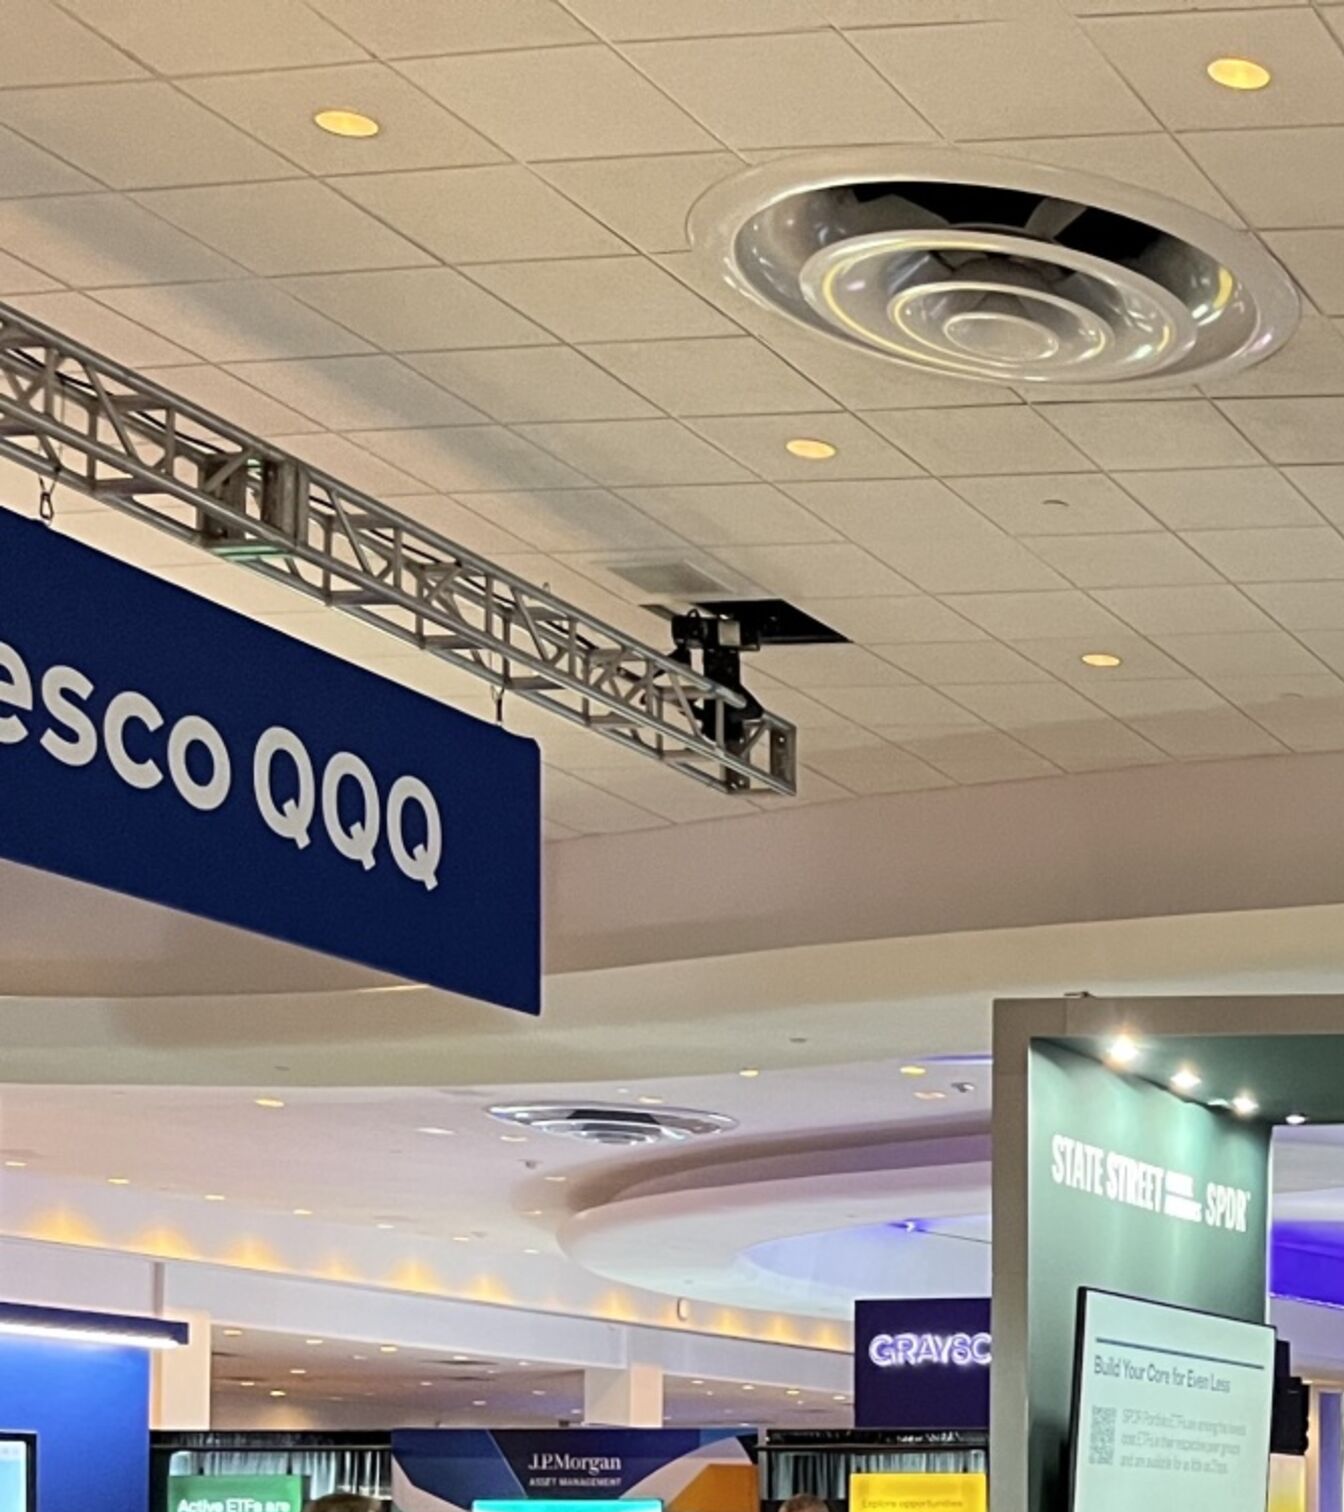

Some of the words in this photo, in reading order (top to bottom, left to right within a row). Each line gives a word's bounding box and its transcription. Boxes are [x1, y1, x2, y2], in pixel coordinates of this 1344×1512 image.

[253, 726, 442, 891] QQQ
[1051, 1134, 1104, 1195] STATE
[1105, 1152, 1165, 1213] STREET
[868, 1332, 993, 1367] GRAYSC
[1094, 1355, 1121, 1378] Build
[1122, 1359, 1146, 1381] Your
[1147, 1363, 1170, 1385] Core
[1172, 1367, 1186, 1387] for
[1187, 1369, 1209, 1390] Even
[1210, 1373, 1231, 1393] Less
[528, 1477, 558, 1487] ASSET
[559, 1477, 622, 1487] MANAGEMENT
